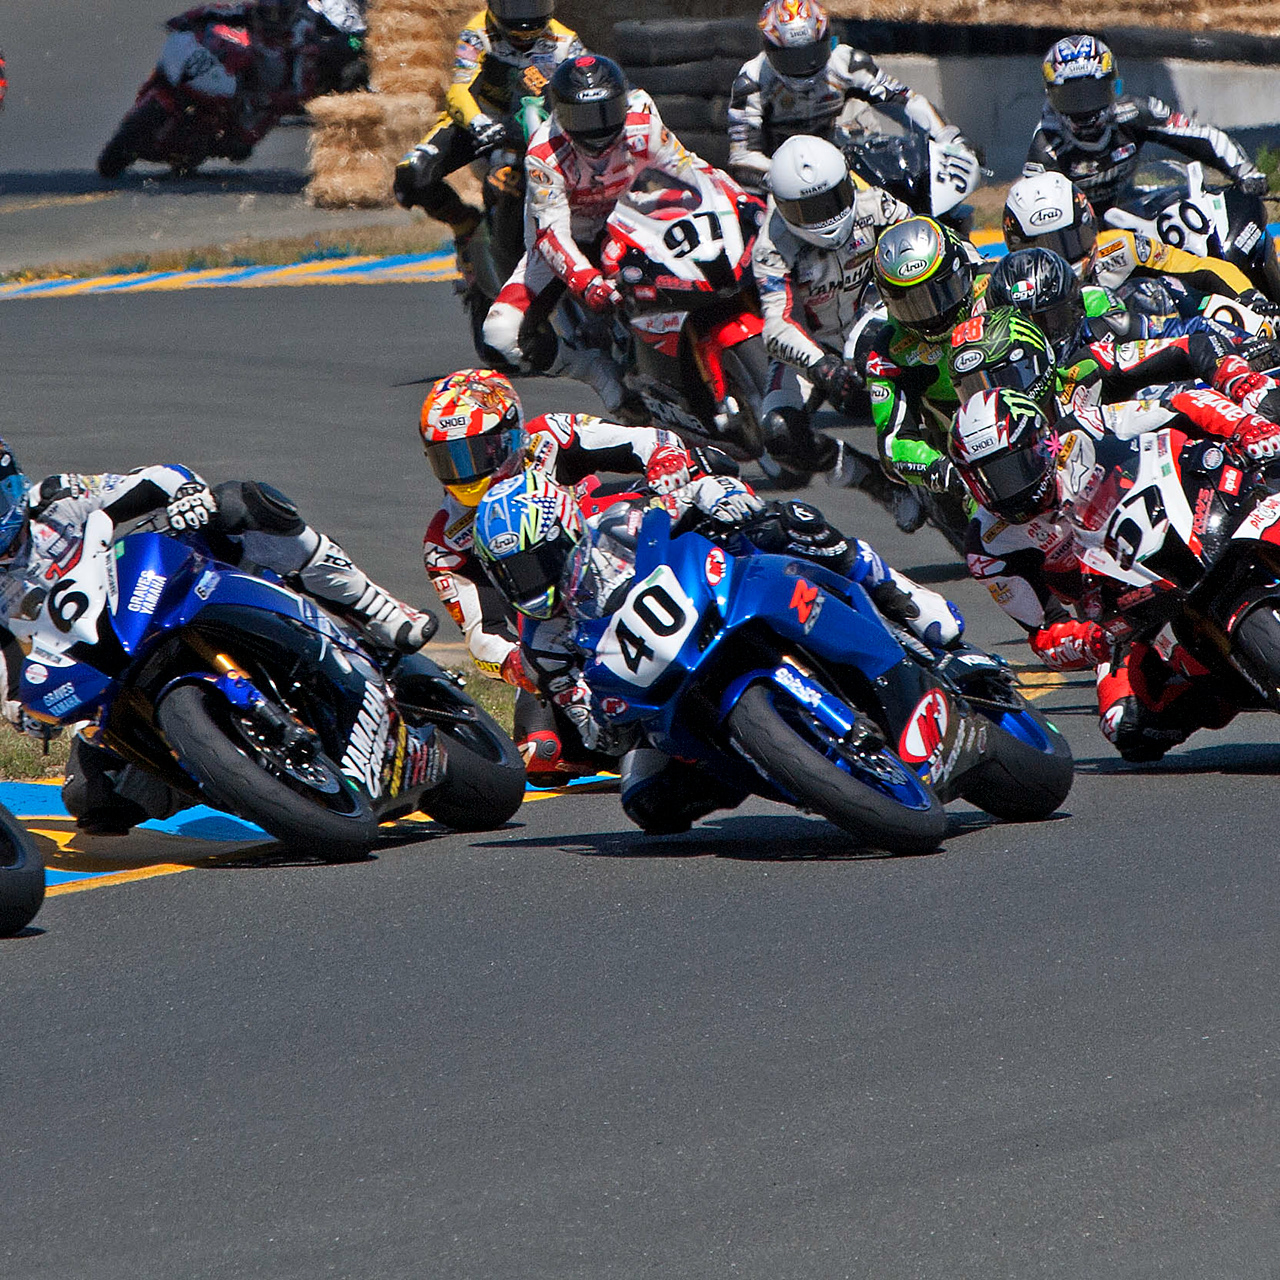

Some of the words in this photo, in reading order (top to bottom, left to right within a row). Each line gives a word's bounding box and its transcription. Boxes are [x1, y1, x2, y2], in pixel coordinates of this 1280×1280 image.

[1032, 208, 1060, 225] Arai
[1155, 200, 1211, 249] 60
[662, 210, 724, 259] 97
[901, 260, 925, 276] Arai
[1012, 287, 1037, 303] agv
[951, 315, 986, 348] 88
[957, 352, 980, 369] Arai
[439, 415, 467, 430] SHOEI
[971, 437, 995, 454] SHOEI
[492, 535, 516, 551] Arai
[1027, 520, 1043, 539] pit
[1039, 533, 1059, 551] bull
[47, 578, 90, 634] 6
[139, 574, 168, 615] YAMAHA
[613, 583, 688, 676] 40
[340, 680, 386, 784] YAMAHA
